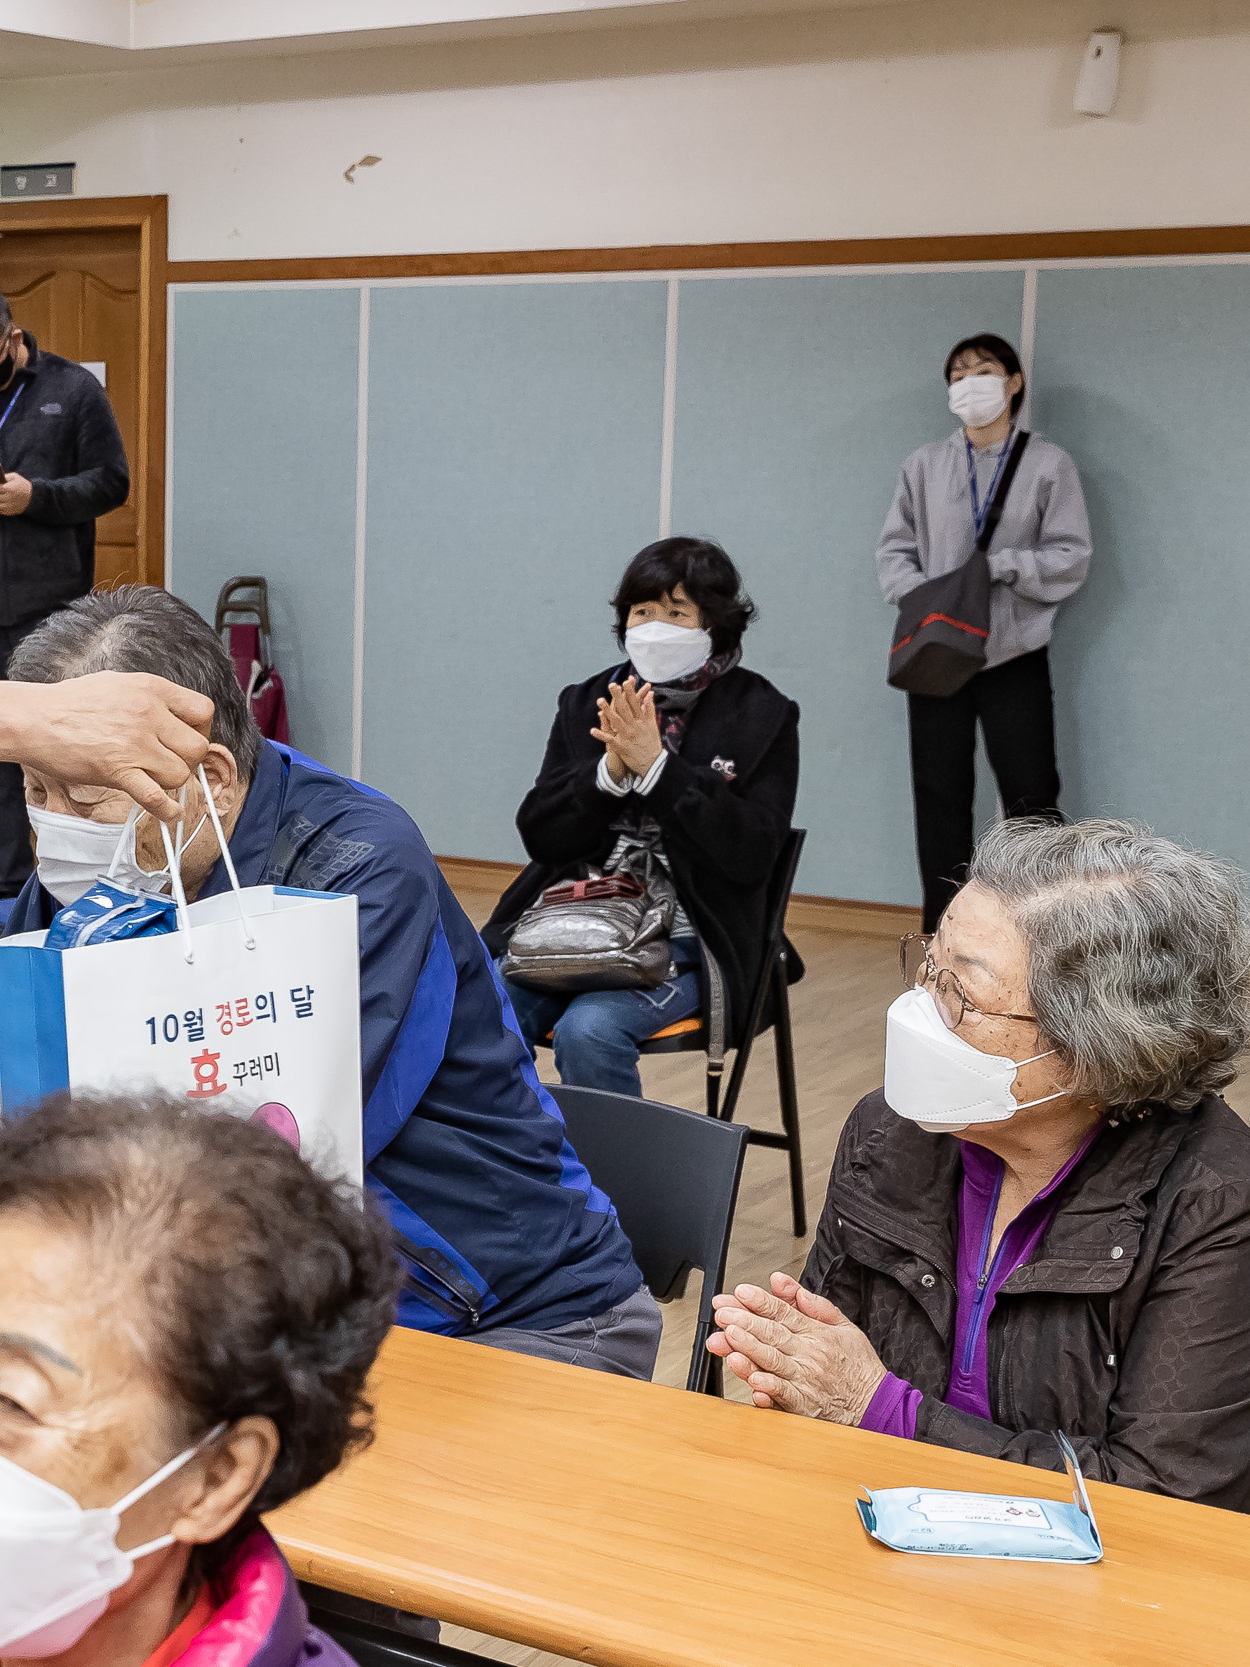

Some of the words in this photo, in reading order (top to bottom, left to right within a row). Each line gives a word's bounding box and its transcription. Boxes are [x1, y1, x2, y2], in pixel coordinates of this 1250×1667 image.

[145, 1007, 205, 1045] 10월
[214, 991, 277, 1036] 경로의
[289, 985, 315, 1019] 달
[186, 1048, 227, 1098] 효
[232, 1052, 281, 1087] 꾸러미
